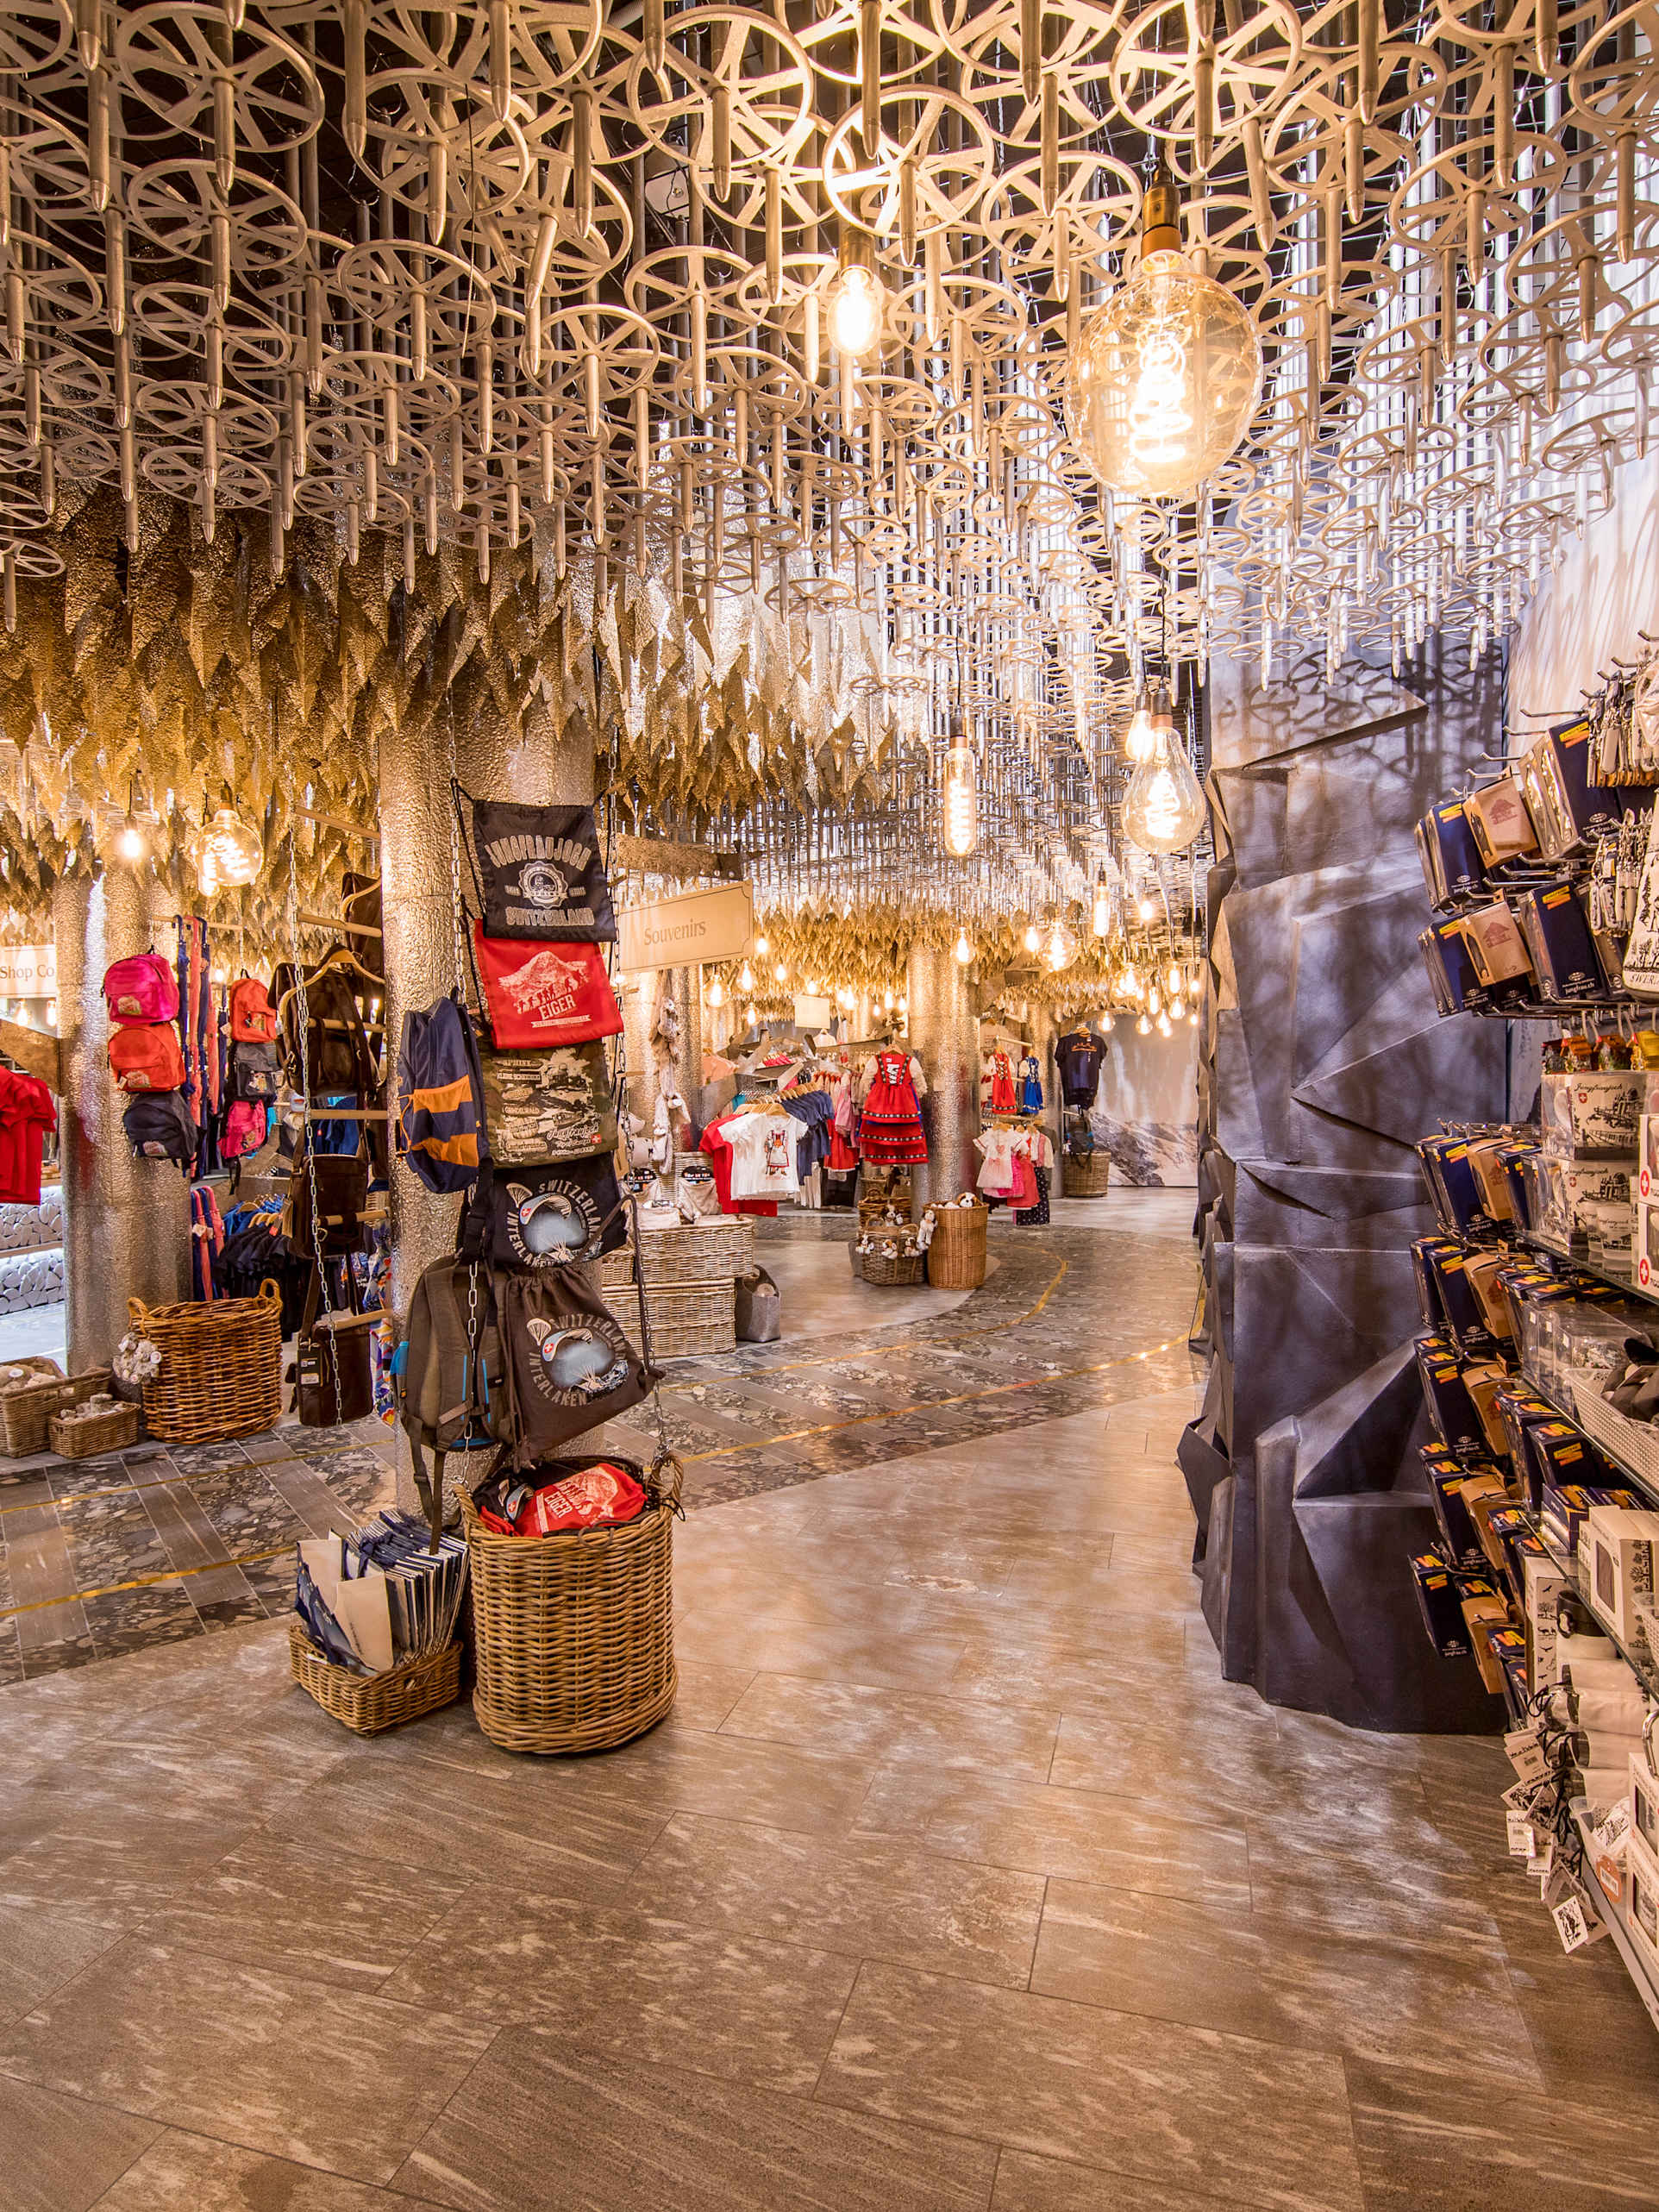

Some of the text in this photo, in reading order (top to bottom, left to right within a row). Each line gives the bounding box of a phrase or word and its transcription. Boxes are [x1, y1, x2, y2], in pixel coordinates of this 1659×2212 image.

[484, 835, 592, 871] JUNGFRAUJOCH
[505, 906, 595, 926] SWITZERLAND
[644, 918, 706, 945] Souvenirs
[0, 965, 33, 981] Shop
[538, 994, 576, 1020] EIGER
[548, 1313, 627, 1360] SWITZERLAND
[529, 1351, 587, 1407] INTERLAKEN
[544, 1491, 573, 1518] EIGER
